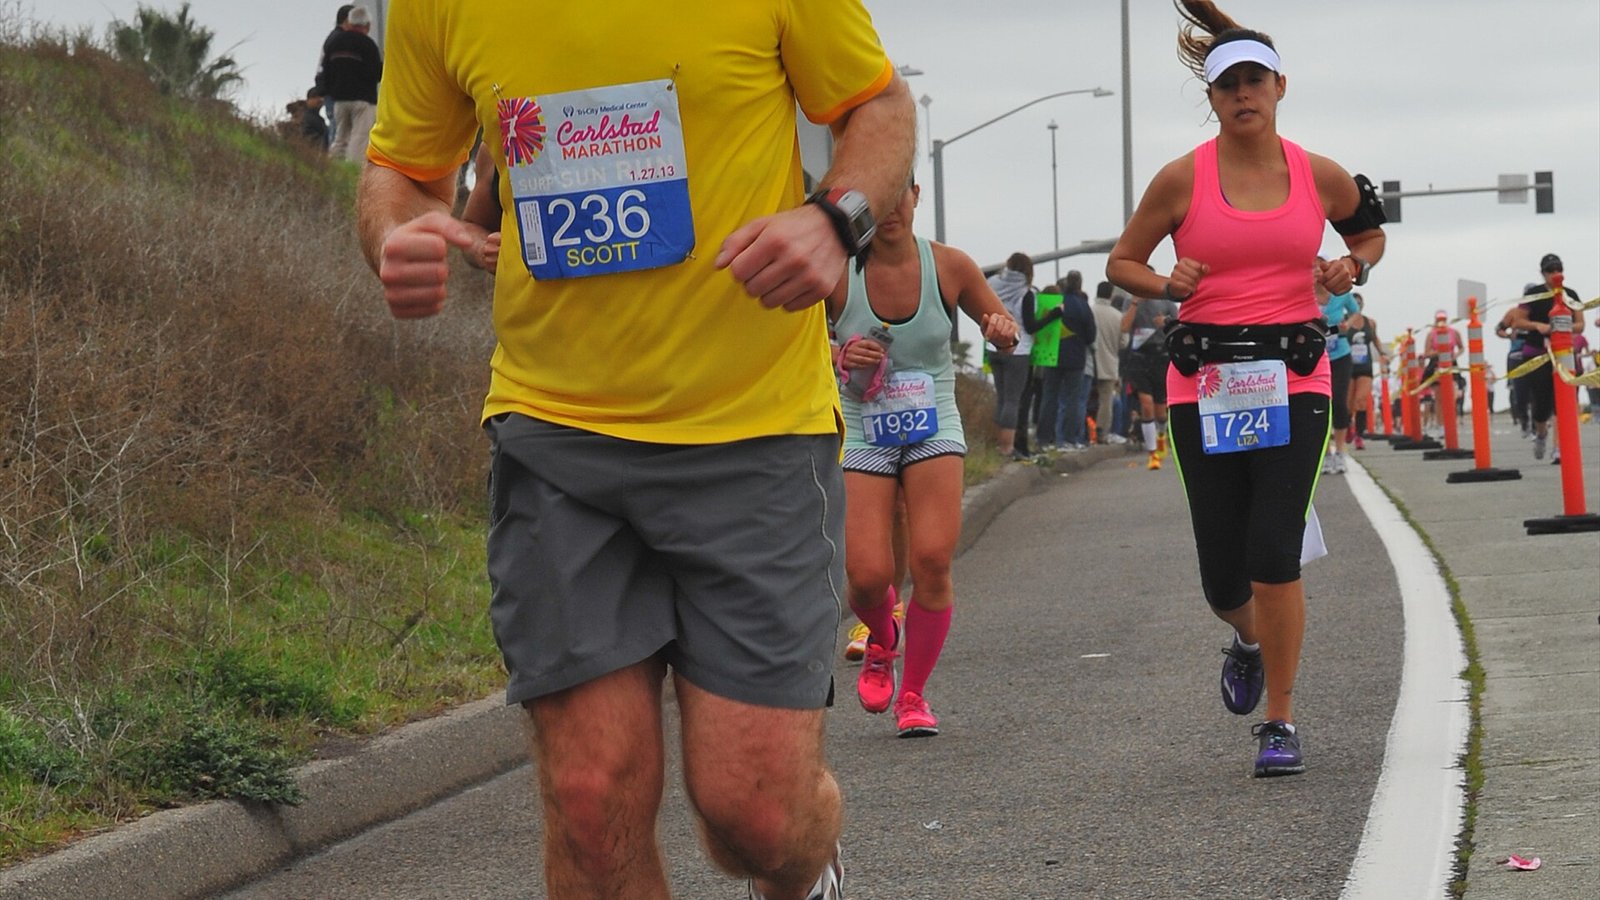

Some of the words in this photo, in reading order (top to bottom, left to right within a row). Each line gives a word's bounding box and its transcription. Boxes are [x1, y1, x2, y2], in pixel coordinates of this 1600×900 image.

[600, 103, 625, 113] Medical
[626, 101, 648, 110] Center
[557, 110, 661, 146] Carlsbad
[562, 135, 662, 160] MARATHON
[560, 167, 607, 189] SUN
[630, 165, 675, 181] 1.27.13
[548, 189, 651, 247] 236
[566, 241, 640, 267] SCOTT
[1227, 372, 1277, 389] Carlsbad
[1228, 384, 1276, 396] MARATHON
[873, 410, 929, 435] 1932
[1220, 409, 1270, 438] 724
[1237, 435, 1260, 447] LIZA
